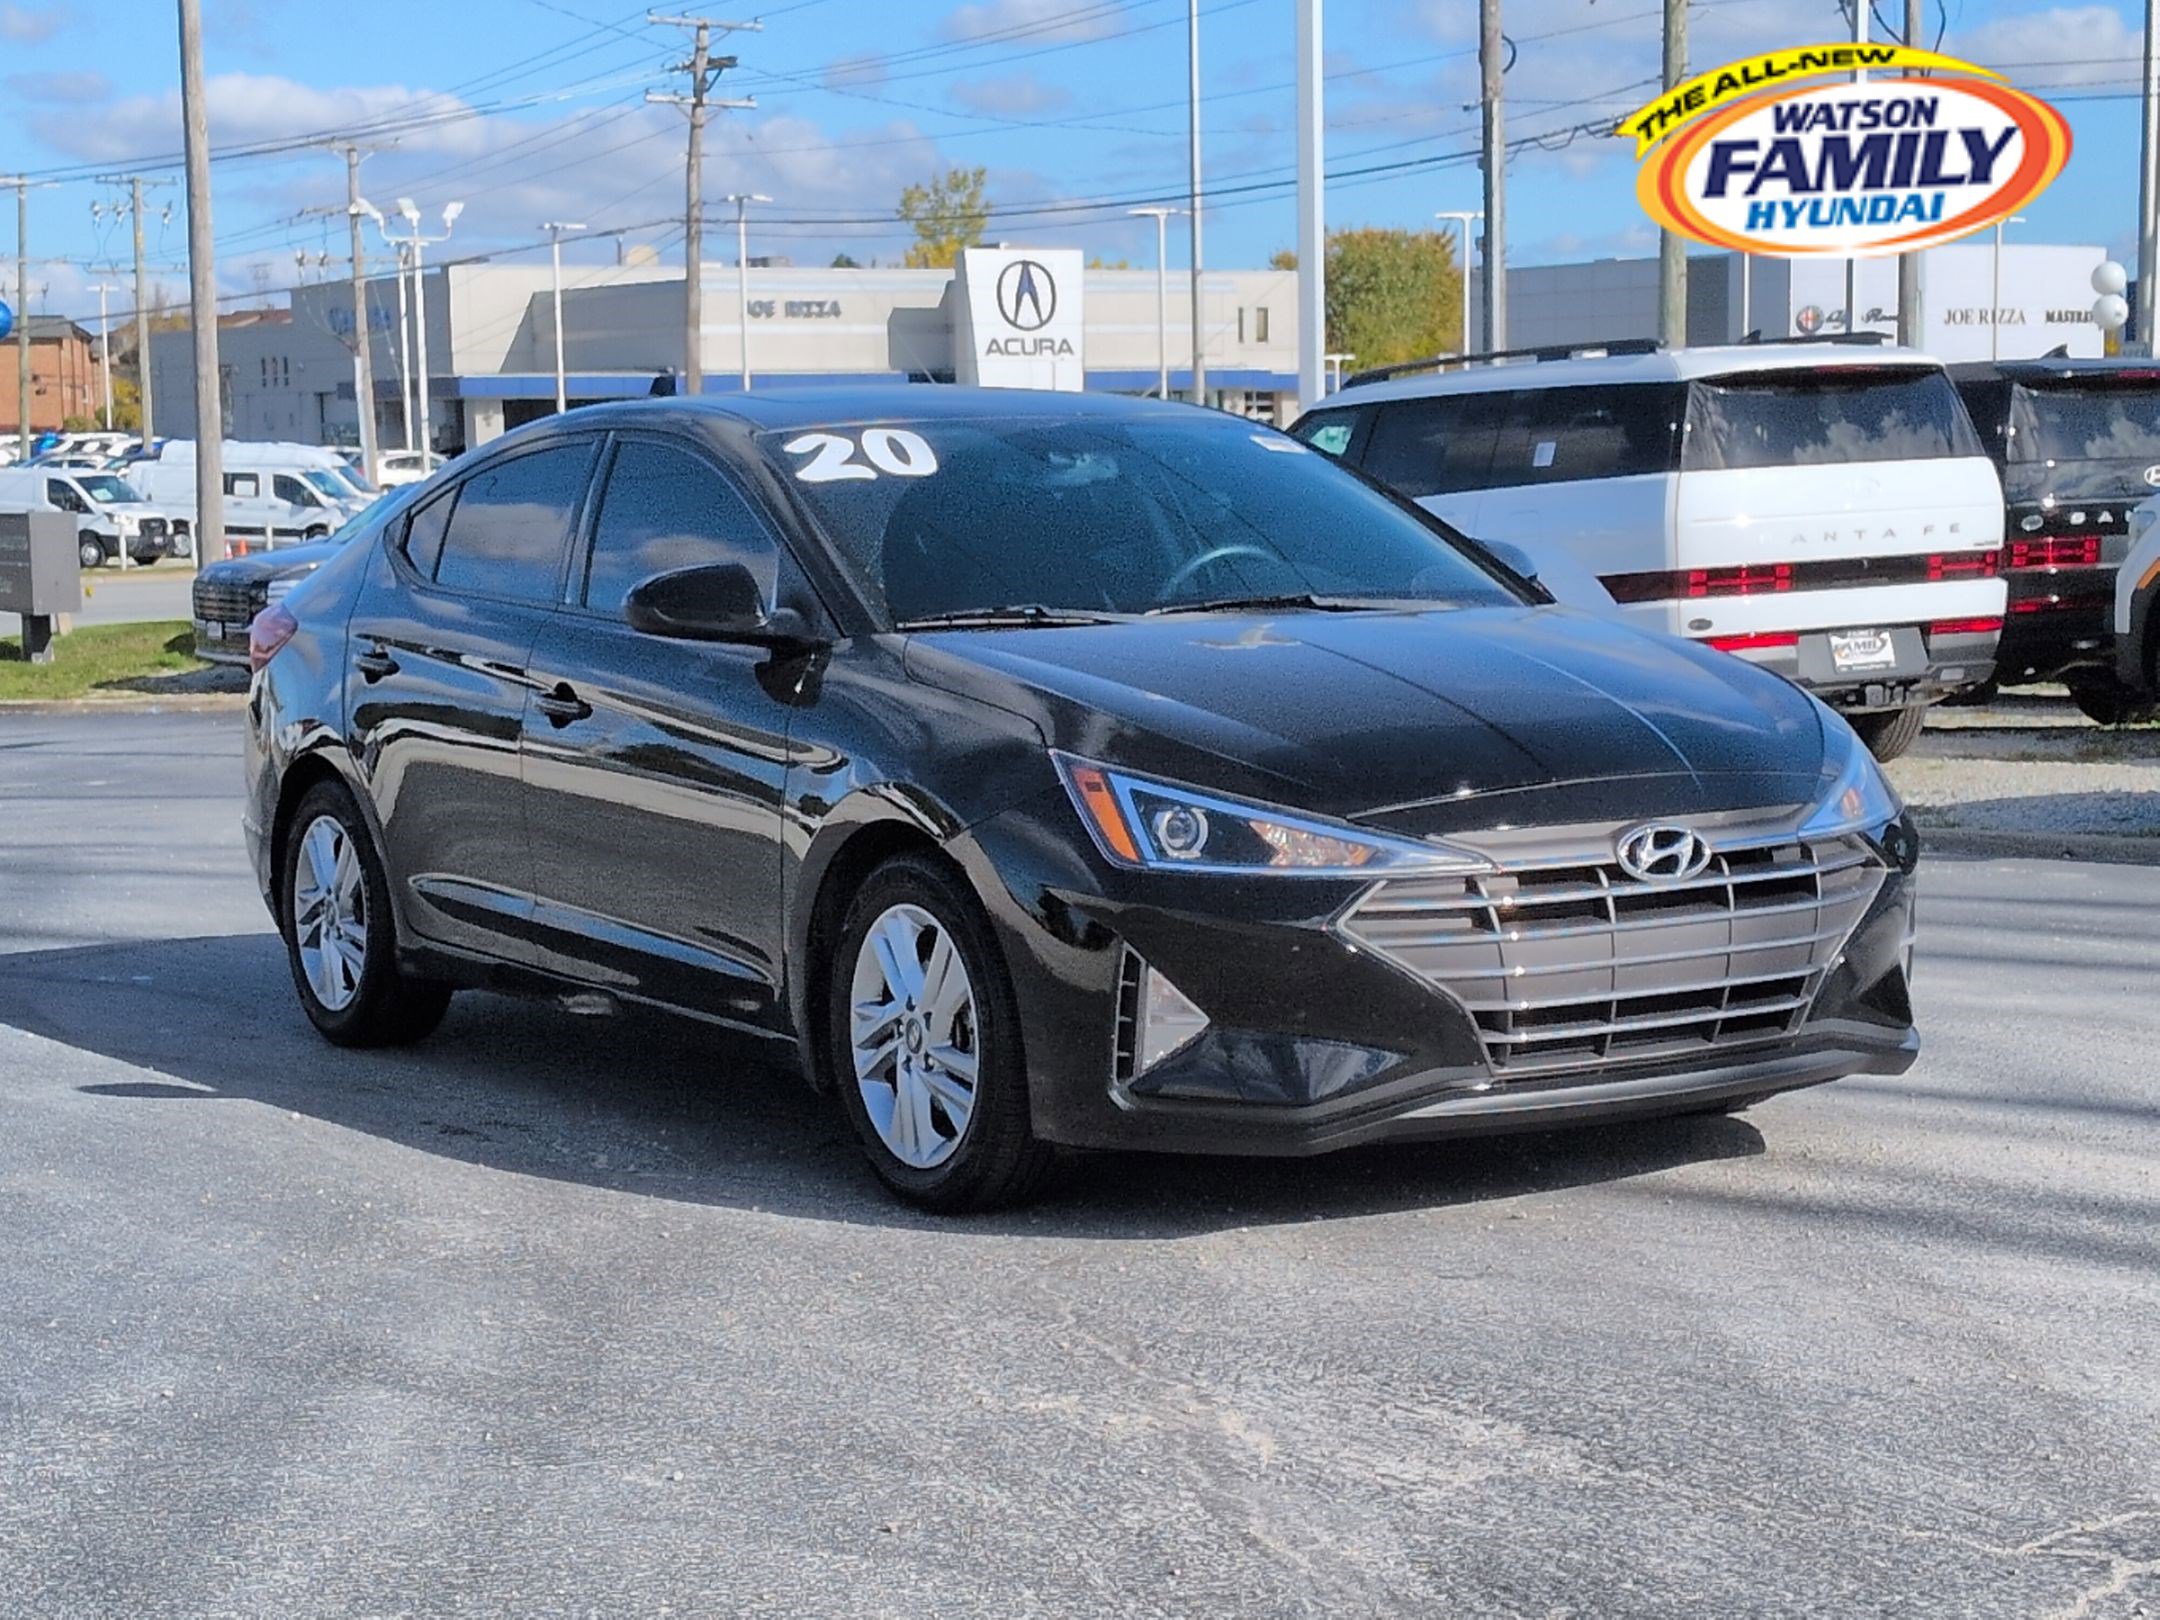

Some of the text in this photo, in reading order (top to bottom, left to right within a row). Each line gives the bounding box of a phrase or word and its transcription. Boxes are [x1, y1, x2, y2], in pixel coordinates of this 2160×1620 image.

[1944, 309, 1974, 326] JOE
[985, 337, 1075, 357] ACURA
[783, 428, 938, 482] 20
[1761, 522, 1961, 546] ANTA FE
